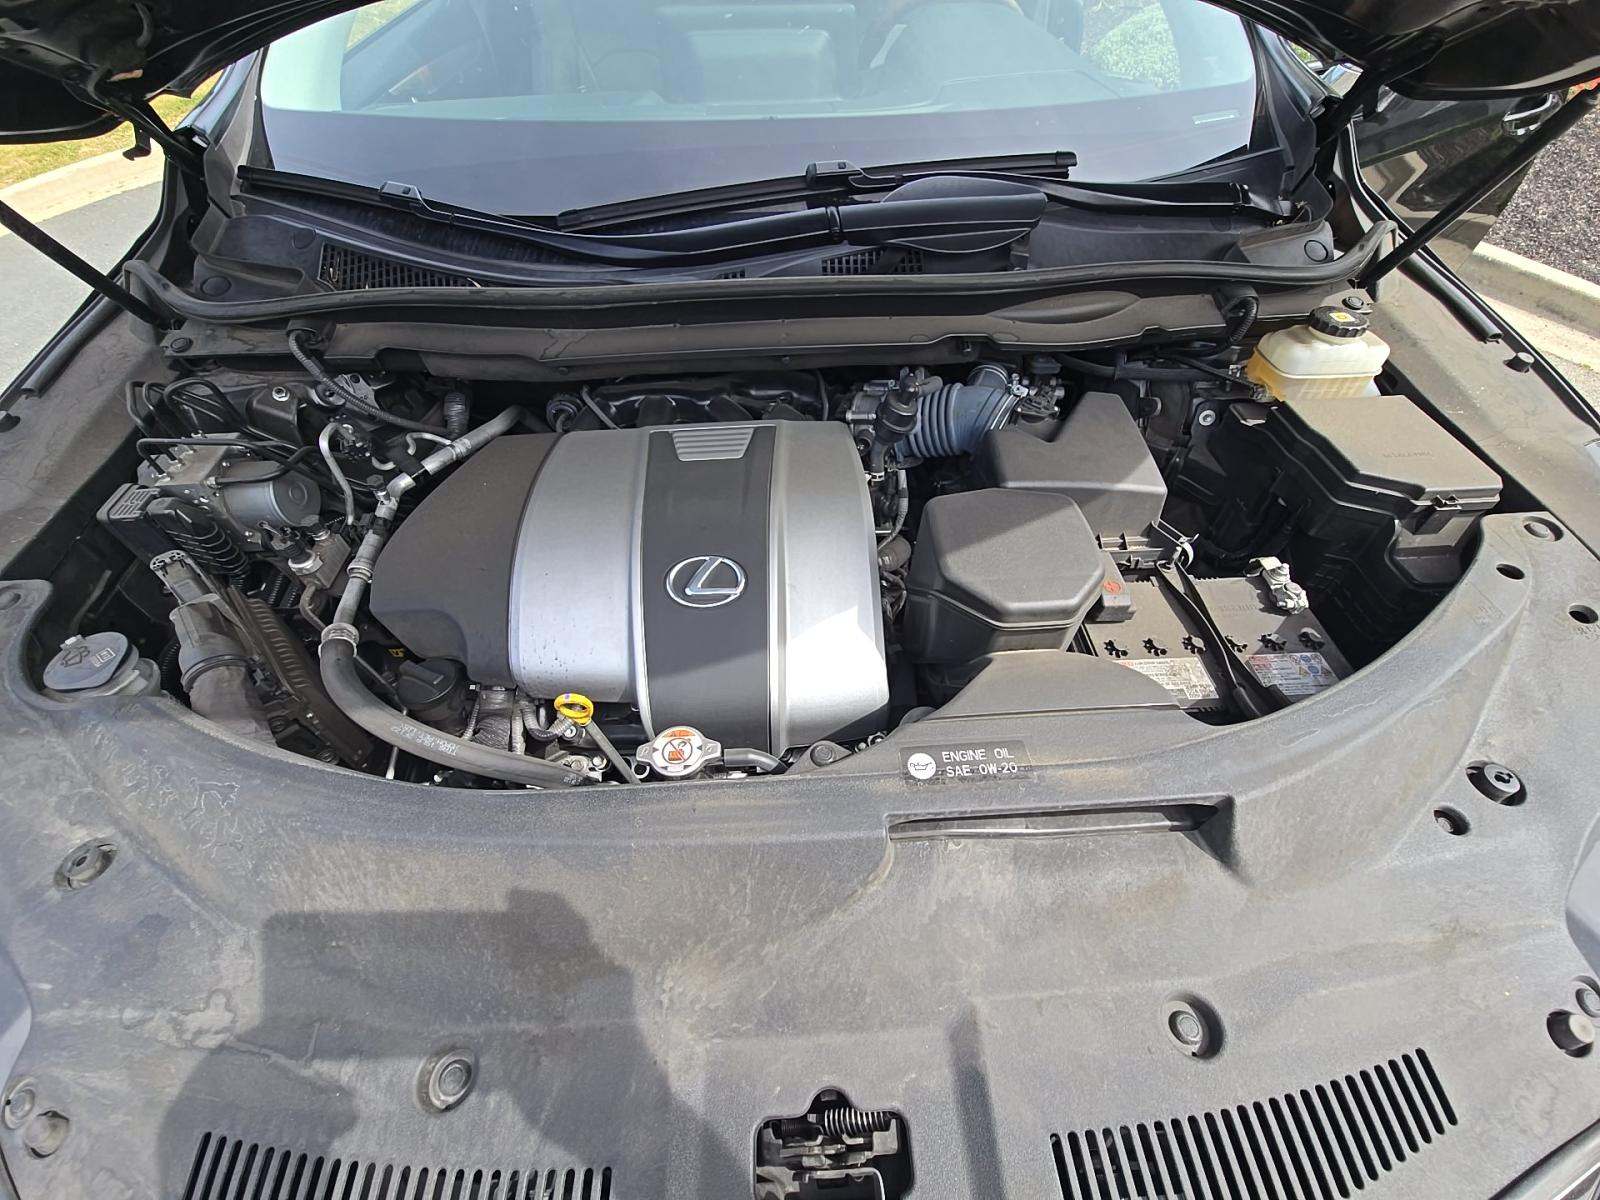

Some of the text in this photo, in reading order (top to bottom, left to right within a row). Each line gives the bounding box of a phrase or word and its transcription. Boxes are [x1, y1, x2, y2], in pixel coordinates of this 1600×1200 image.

[941, 747, 1015, 763] ENGINE OIL
[946, 761, 1018, 778] SAE 0W-20
